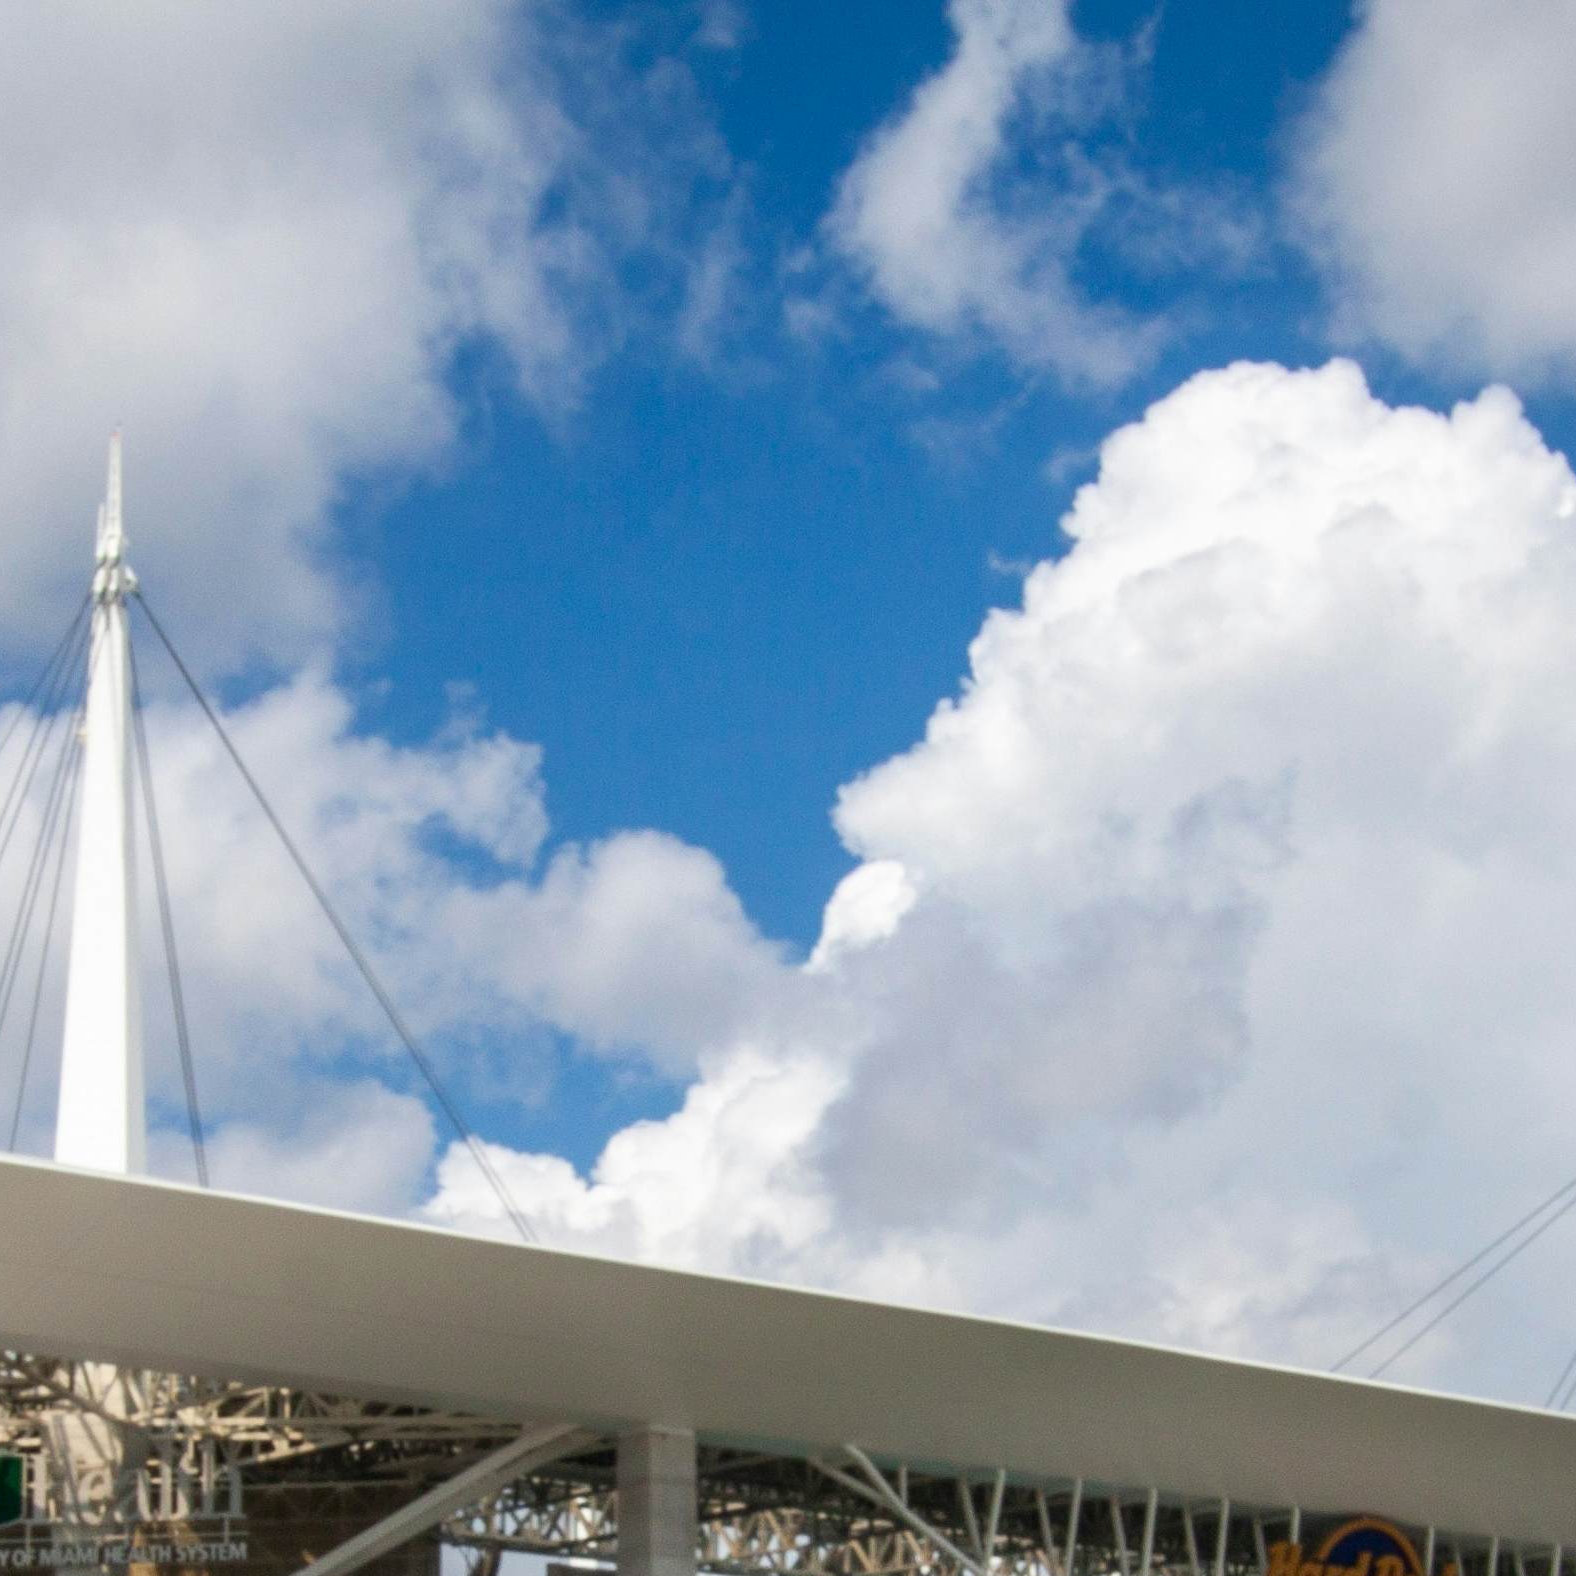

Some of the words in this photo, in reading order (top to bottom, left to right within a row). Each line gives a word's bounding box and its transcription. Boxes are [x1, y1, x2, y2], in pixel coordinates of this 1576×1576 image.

[13, 1548, 34, 1567] OF
[39, 1545, 99, 1567] MIAMI
[105, 1543, 172, 1564] HEALTH
[176, 1541, 248, 1561] SYSTEM
